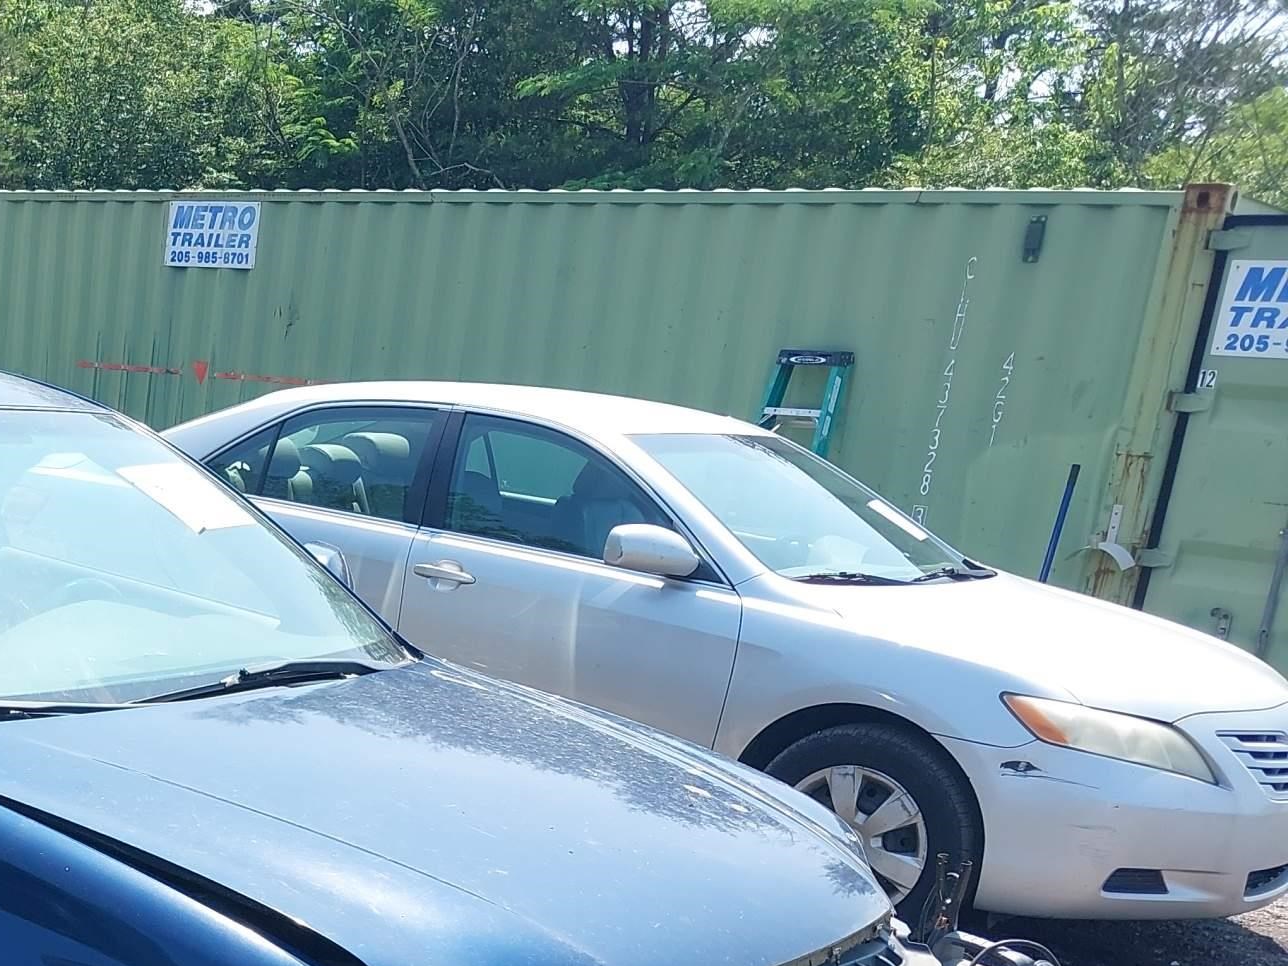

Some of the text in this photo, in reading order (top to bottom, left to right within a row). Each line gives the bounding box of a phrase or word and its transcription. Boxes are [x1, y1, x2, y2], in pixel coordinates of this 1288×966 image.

[172, 205, 257, 231] METRO
[170, 232, 252, 249] TRAILER
[170, 250, 249, 264] 205-985-8701
[1234, 266, 1288, 303] M
[1224, 333, 1288, 353] 205-
[1199, 370, 1216, 388] 12
